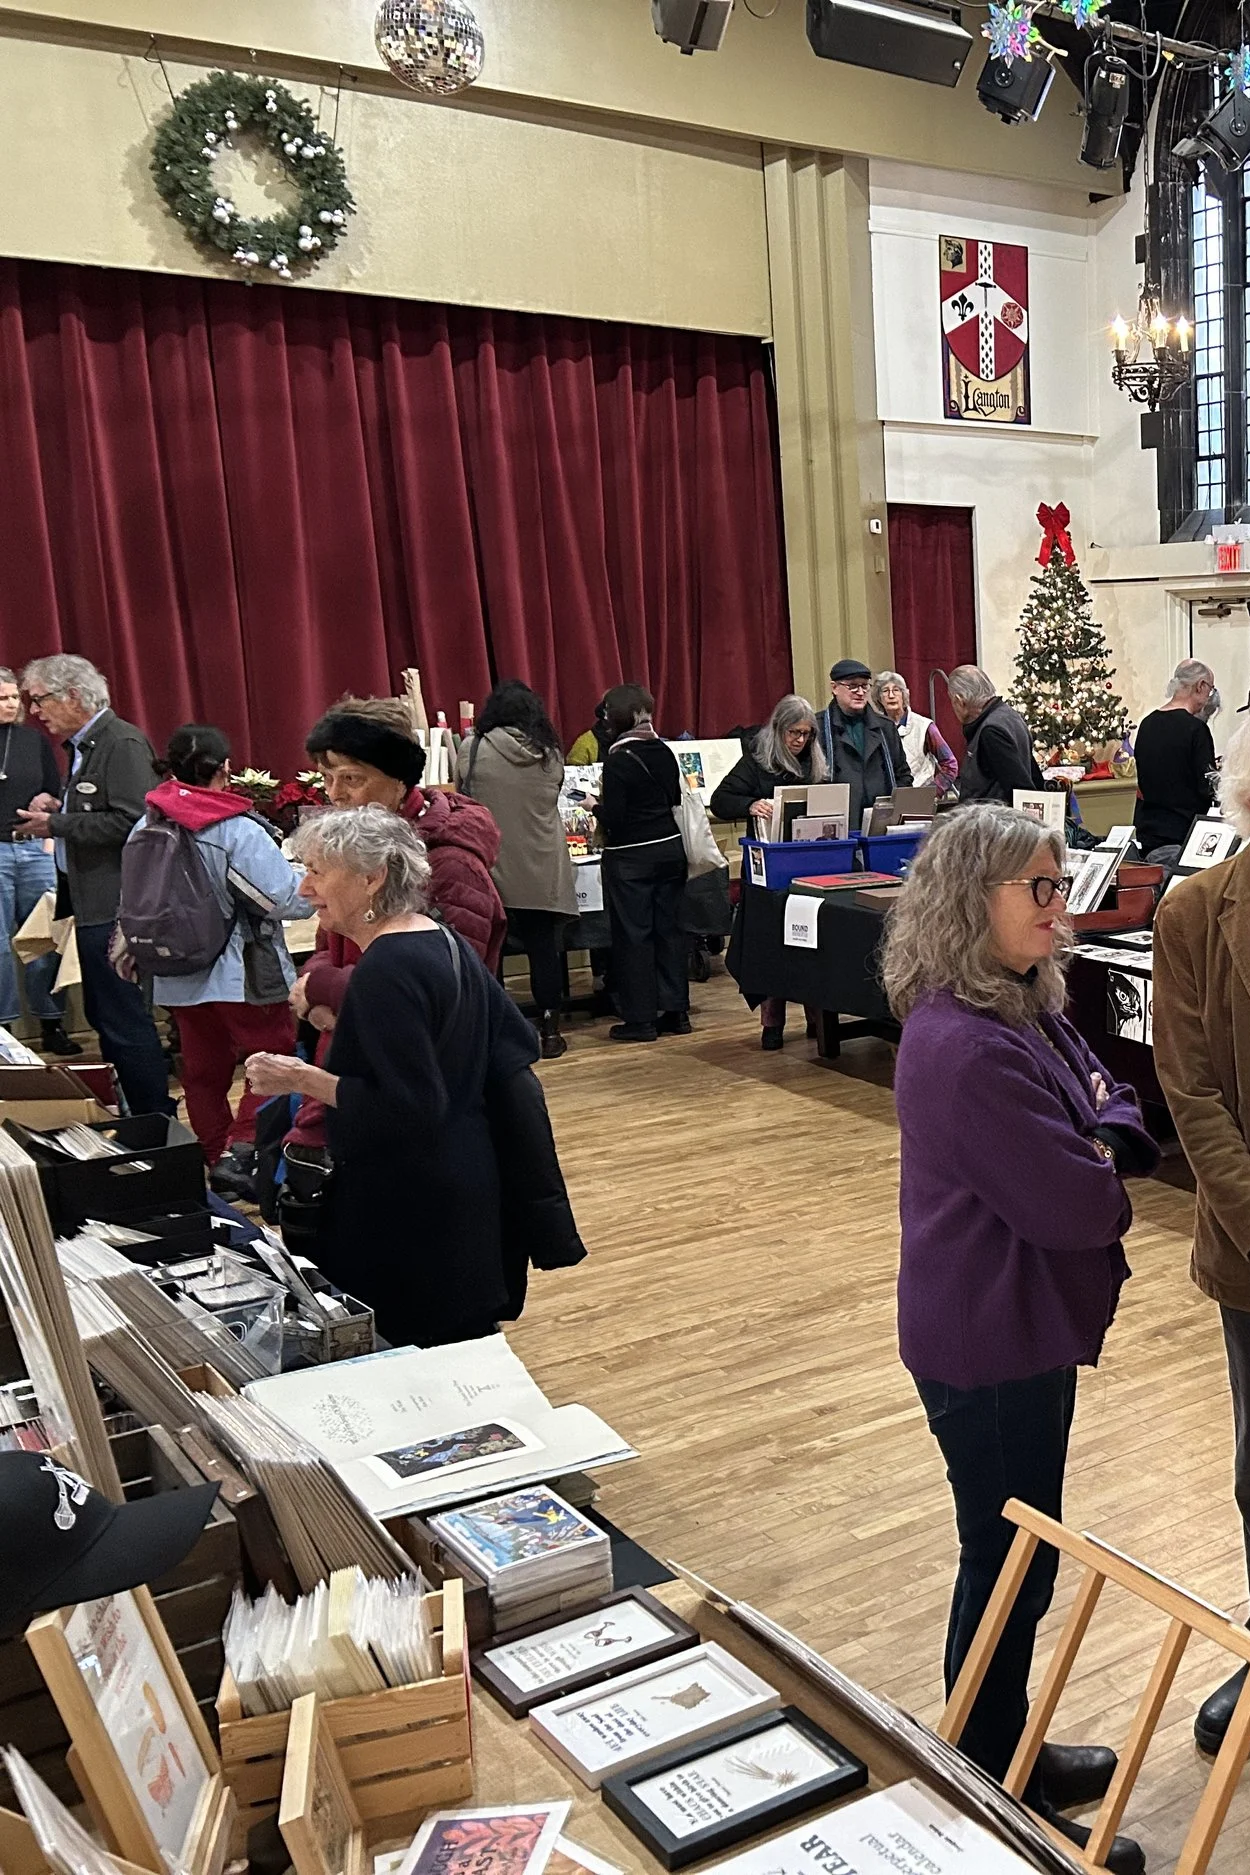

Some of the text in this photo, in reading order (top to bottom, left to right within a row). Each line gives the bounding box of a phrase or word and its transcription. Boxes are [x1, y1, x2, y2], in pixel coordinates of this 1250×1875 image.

[962, 374, 1010, 417] Langton
[1218, 545, 1241, 571] EXIT
[792, 924, 808, 932] BOUND
[887, 1832, 942, 1875] calendar
